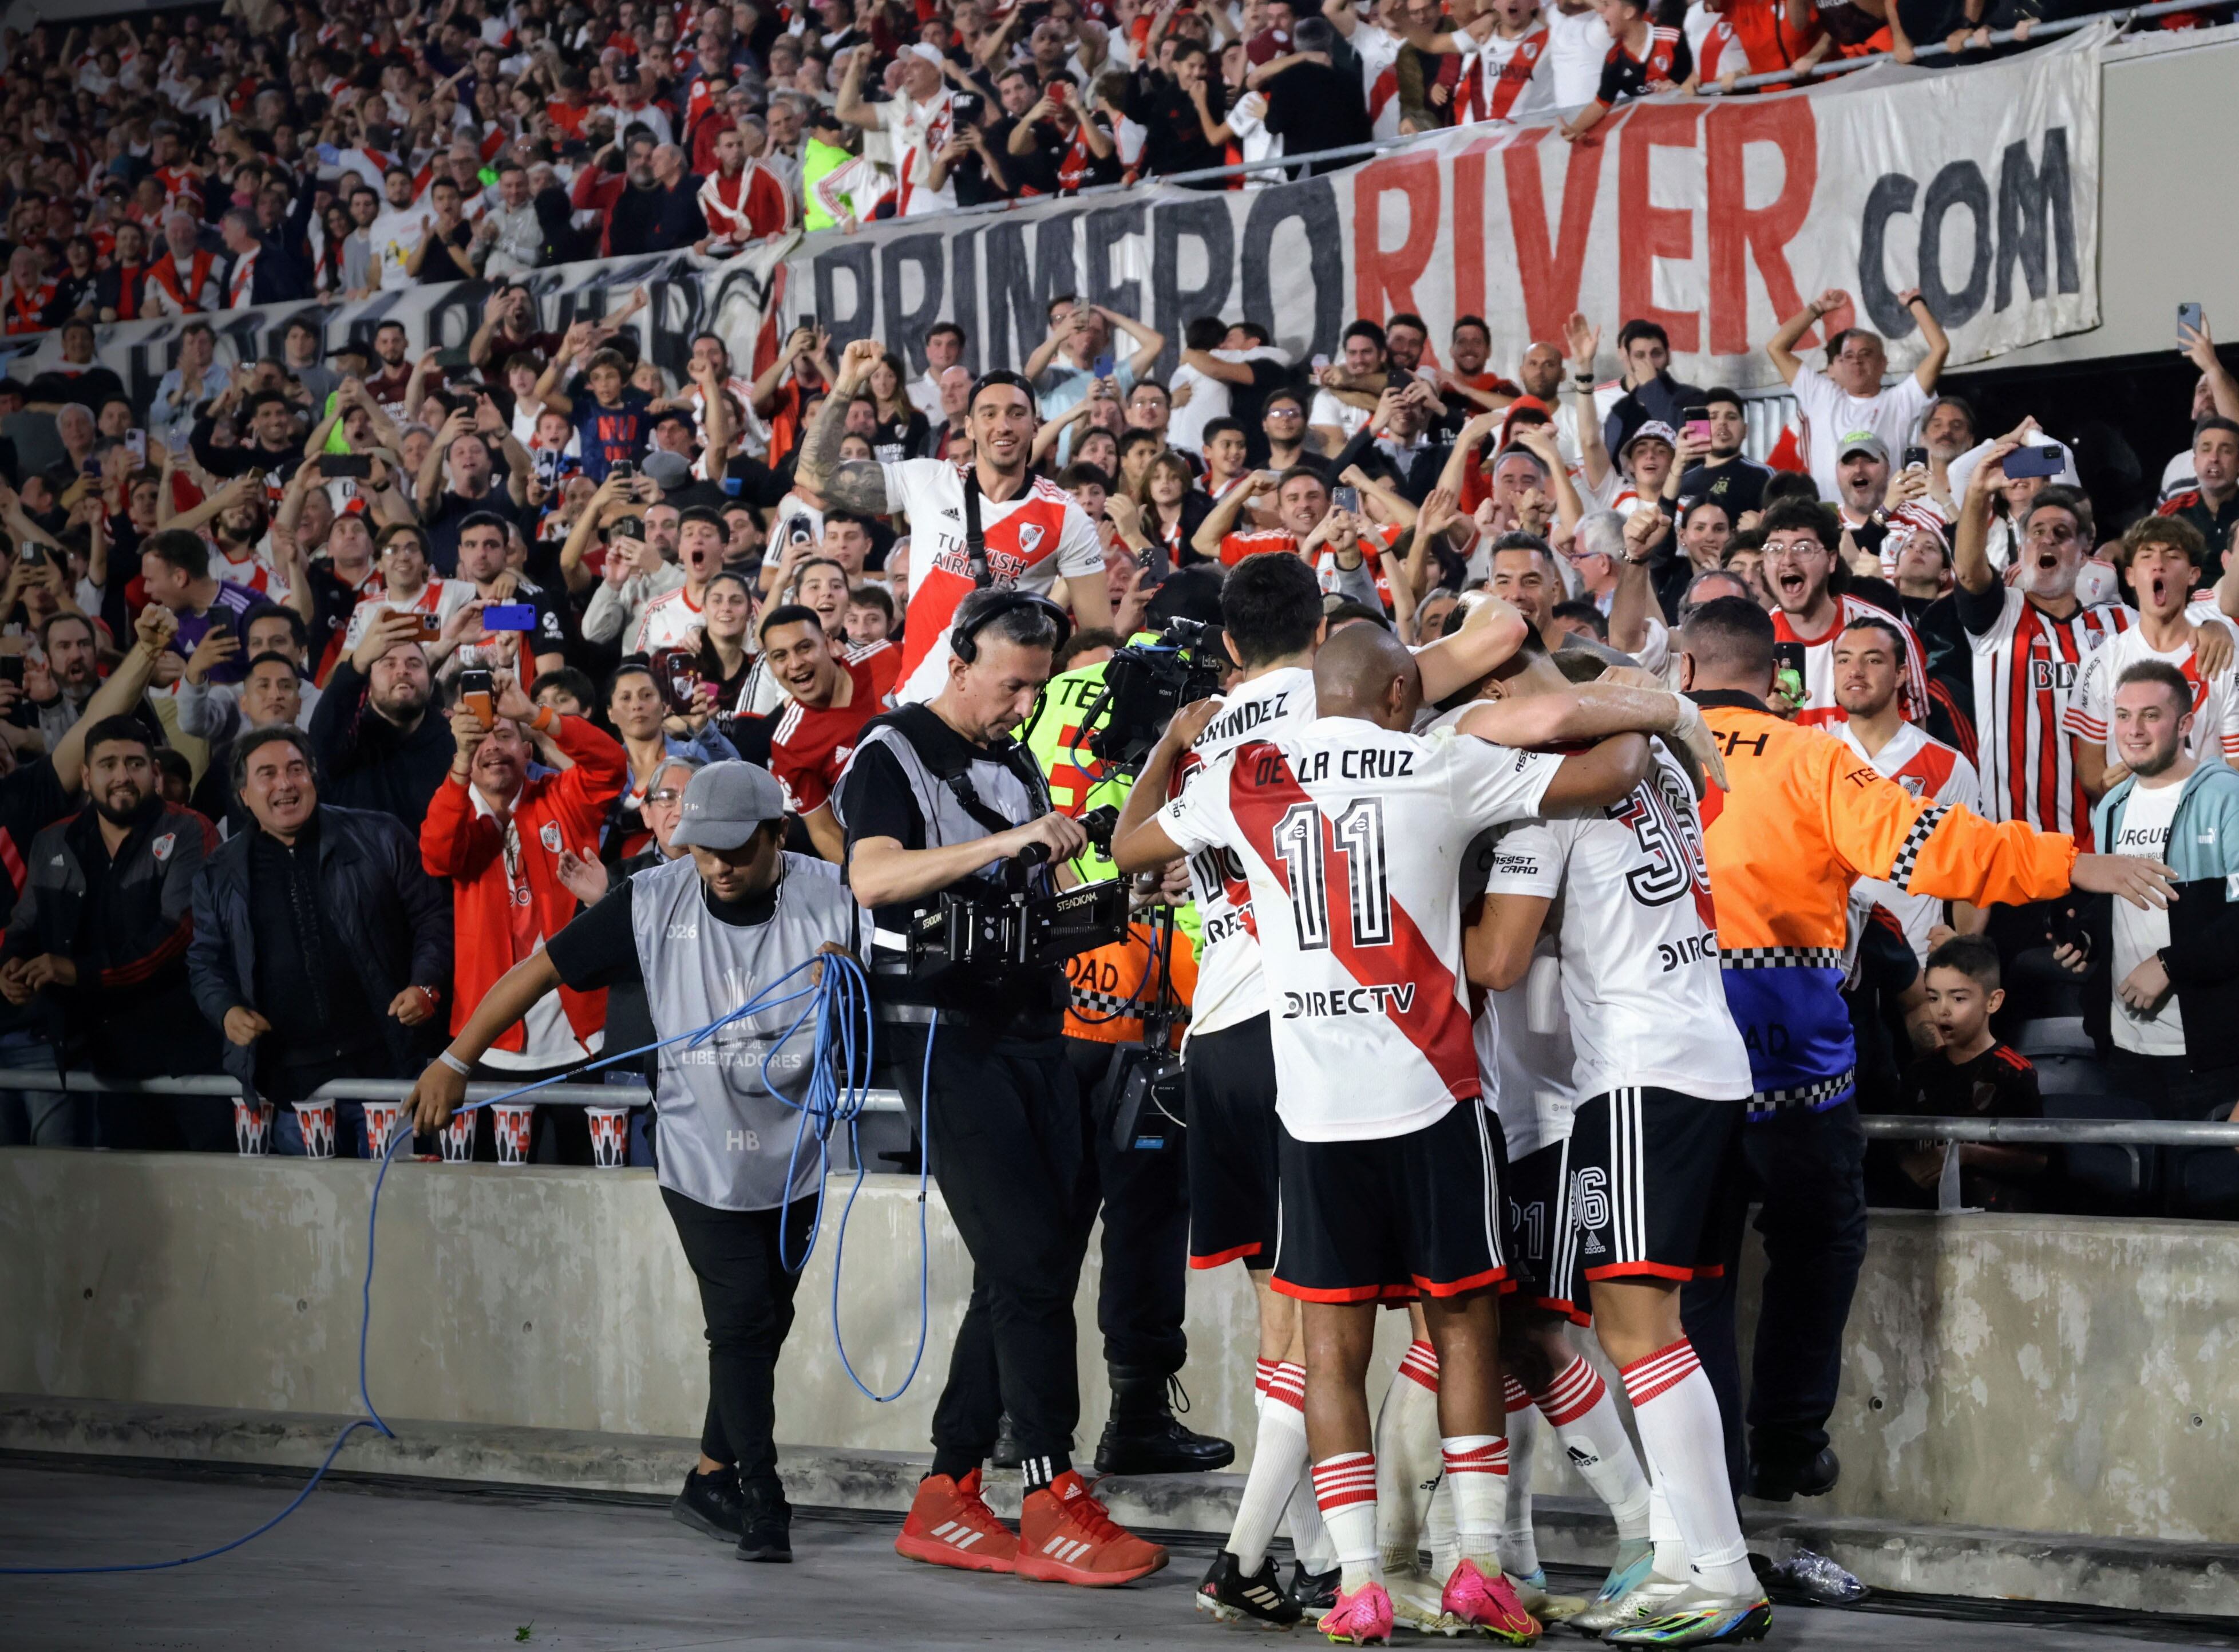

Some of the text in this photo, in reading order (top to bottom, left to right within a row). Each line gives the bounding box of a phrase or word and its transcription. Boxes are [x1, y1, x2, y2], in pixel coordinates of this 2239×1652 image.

[2082, 656, 2100, 709] NETSHOES
[1256, 749, 1414, 787] DE LA CRUZ
[1272, 794, 1394, 951] 11
[1501, 865, 1538, 875] CARD
[1056, 891, 1098, 912] STEADICAM
[922, 911, 943, 930] STEADICAM
[1281, 982, 1417, 1019] DIRECTV
[726, 1129, 760, 1152] HB
[1584, 1244, 1607, 1255] adidas
